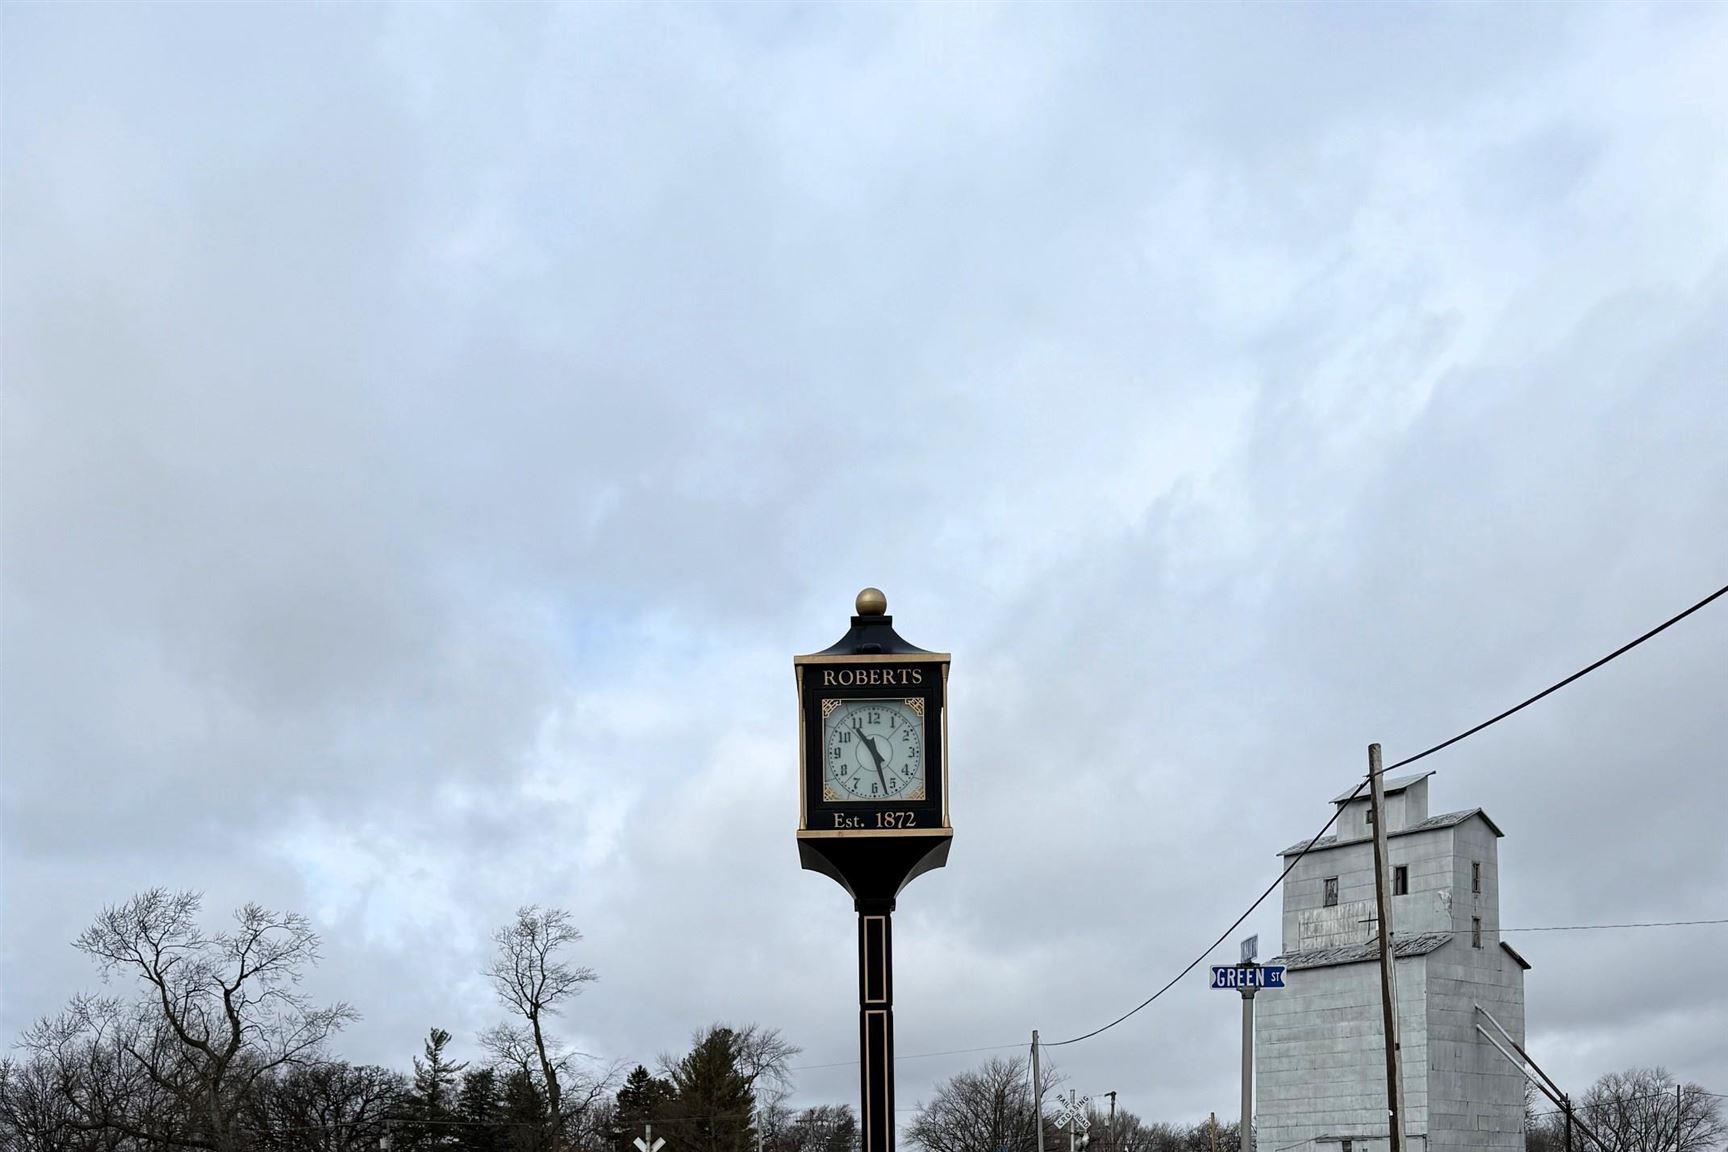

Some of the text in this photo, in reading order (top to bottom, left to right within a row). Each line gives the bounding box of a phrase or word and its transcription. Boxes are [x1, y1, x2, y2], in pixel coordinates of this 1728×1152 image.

[823, 669, 922, 686] ROBERTS
[852, 717, 863, 729] 11
[868, 712, 881, 724] 12
[890, 716, 895, 728] 1
[839, 731, 851, 743] 10
[902, 729, 910, 742] 2
[834, 747, 841, 759] 9
[907, 746, 915, 758] 3
[840, 763, 848, 776] 8
[901, 763, 910, 776] 4
[853, 777, 861, 789] 7
[871, 782, 878, 794] 6
[889, 777, 896, 789] 5
[834, 811, 917, 829] Est. 1872
[1216, 968, 1280, 987] GREEN ST
[1056, 1094, 1090, 1128] RAIL ROAD
[1057, 1095, 1089, 1126] CROSSING
